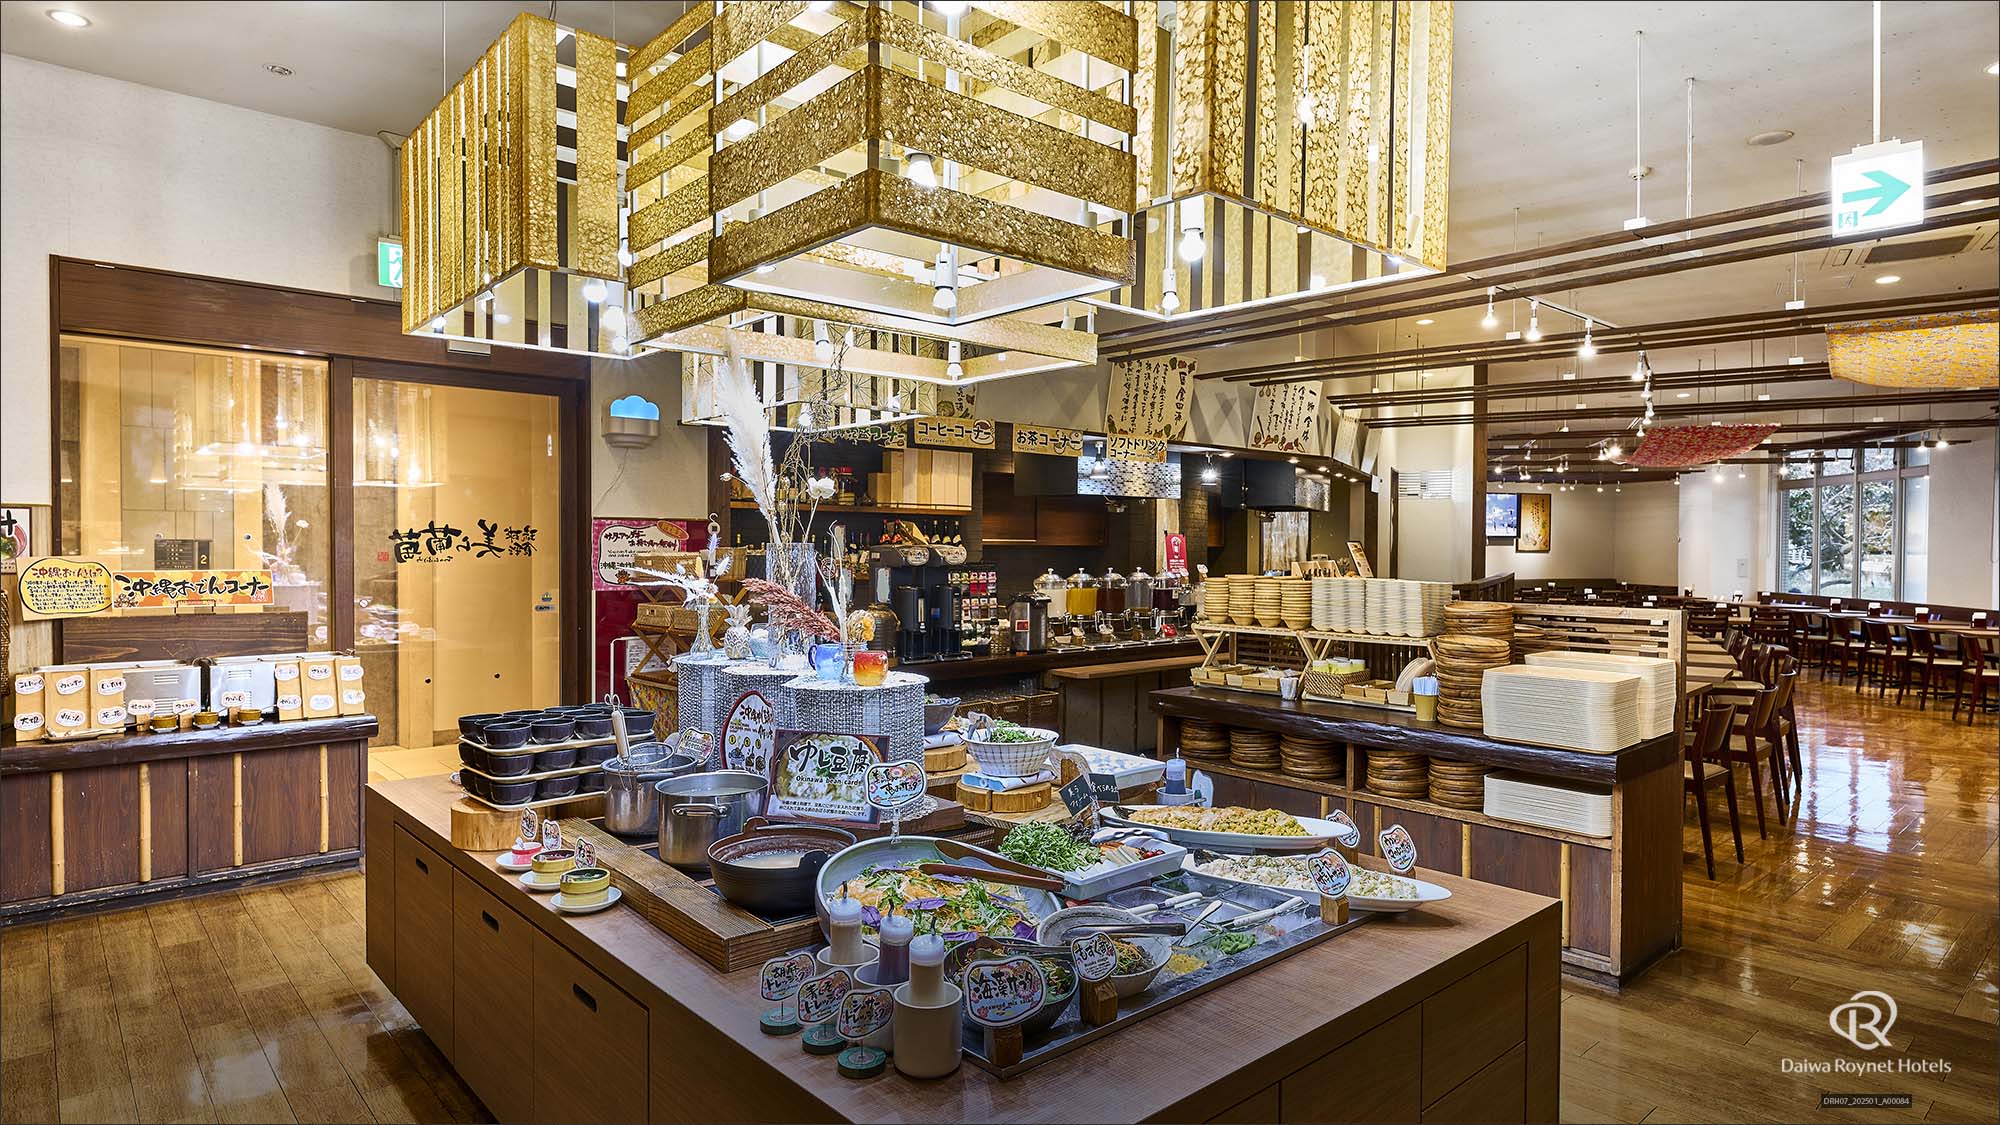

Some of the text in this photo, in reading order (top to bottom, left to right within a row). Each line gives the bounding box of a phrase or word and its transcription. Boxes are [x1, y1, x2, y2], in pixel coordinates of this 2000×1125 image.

[918, 421, 992, 440] コーヒーコーナー
[1016, 430, 1081, 449] お茶コーナー
[1110, 437, 1167, 452] ソフトドリンク
[1110, 448, 1136, 459] コーナー
[199, 555, 208, 565] 2
[114, 574, 270, 600] 沖縄おでんコーナー
[20, 716, 39, 725] 大根
[788, 740, 870, 775] ゆし豆腐
[796, 774, 824, 783] Okinawa
[766, 969, 805, 991] ドレッシング
[970, 969, 1034, 1001] 海藻サラダ
[804, 988, 846, 1014] ドレッシング
[845, 1007, 885, 1025] ドレッシング
